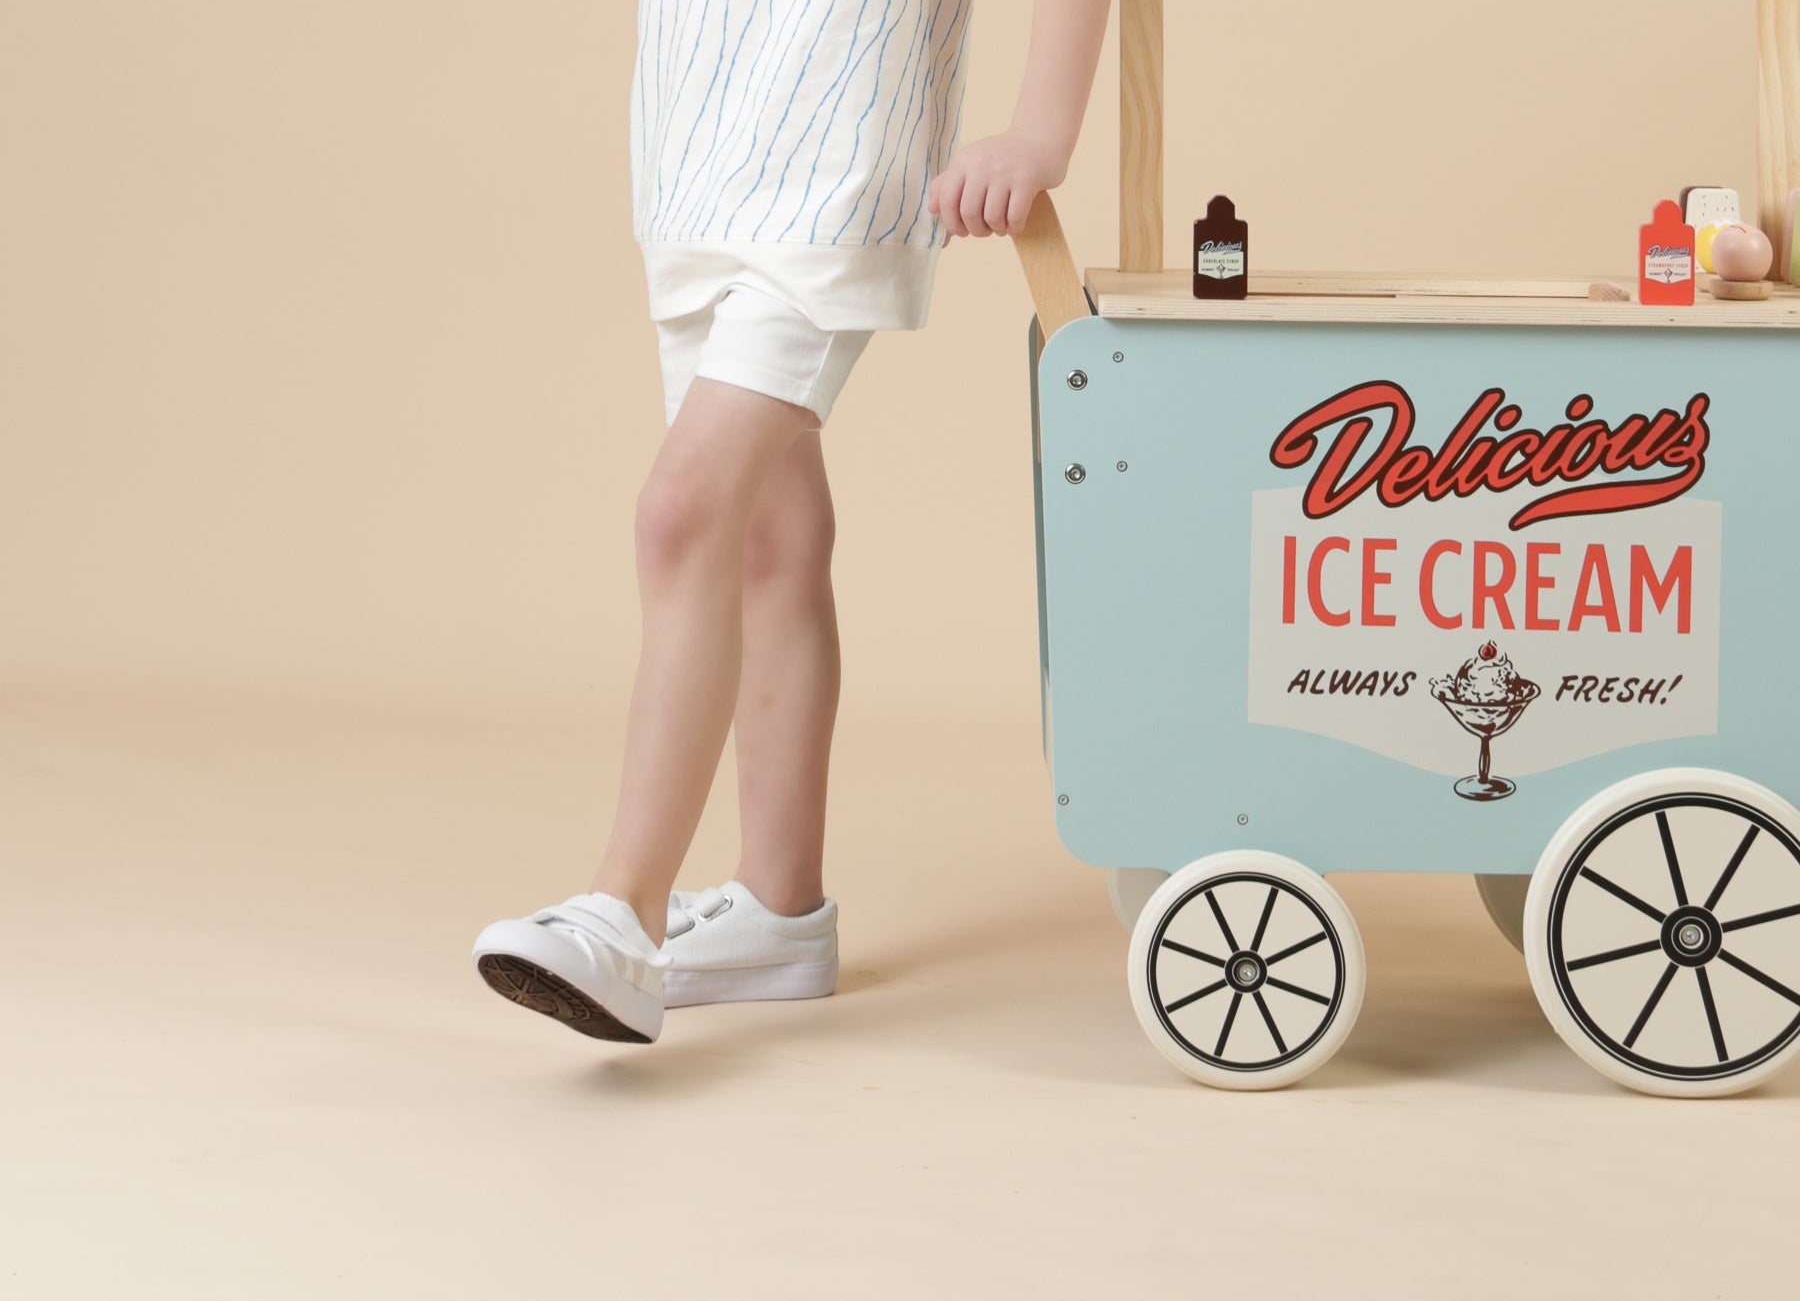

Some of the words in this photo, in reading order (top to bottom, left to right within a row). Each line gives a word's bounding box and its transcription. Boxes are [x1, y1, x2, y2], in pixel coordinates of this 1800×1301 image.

[1269, 380, 1710, 531] Delicious
[1282, 536, 1398, 627] ICE
[1419, 539, 1693, 634] CREAM
[1287, 669, 1417, 697] ALWAYS
[1555, 674, 1683, 705] FRESH!
